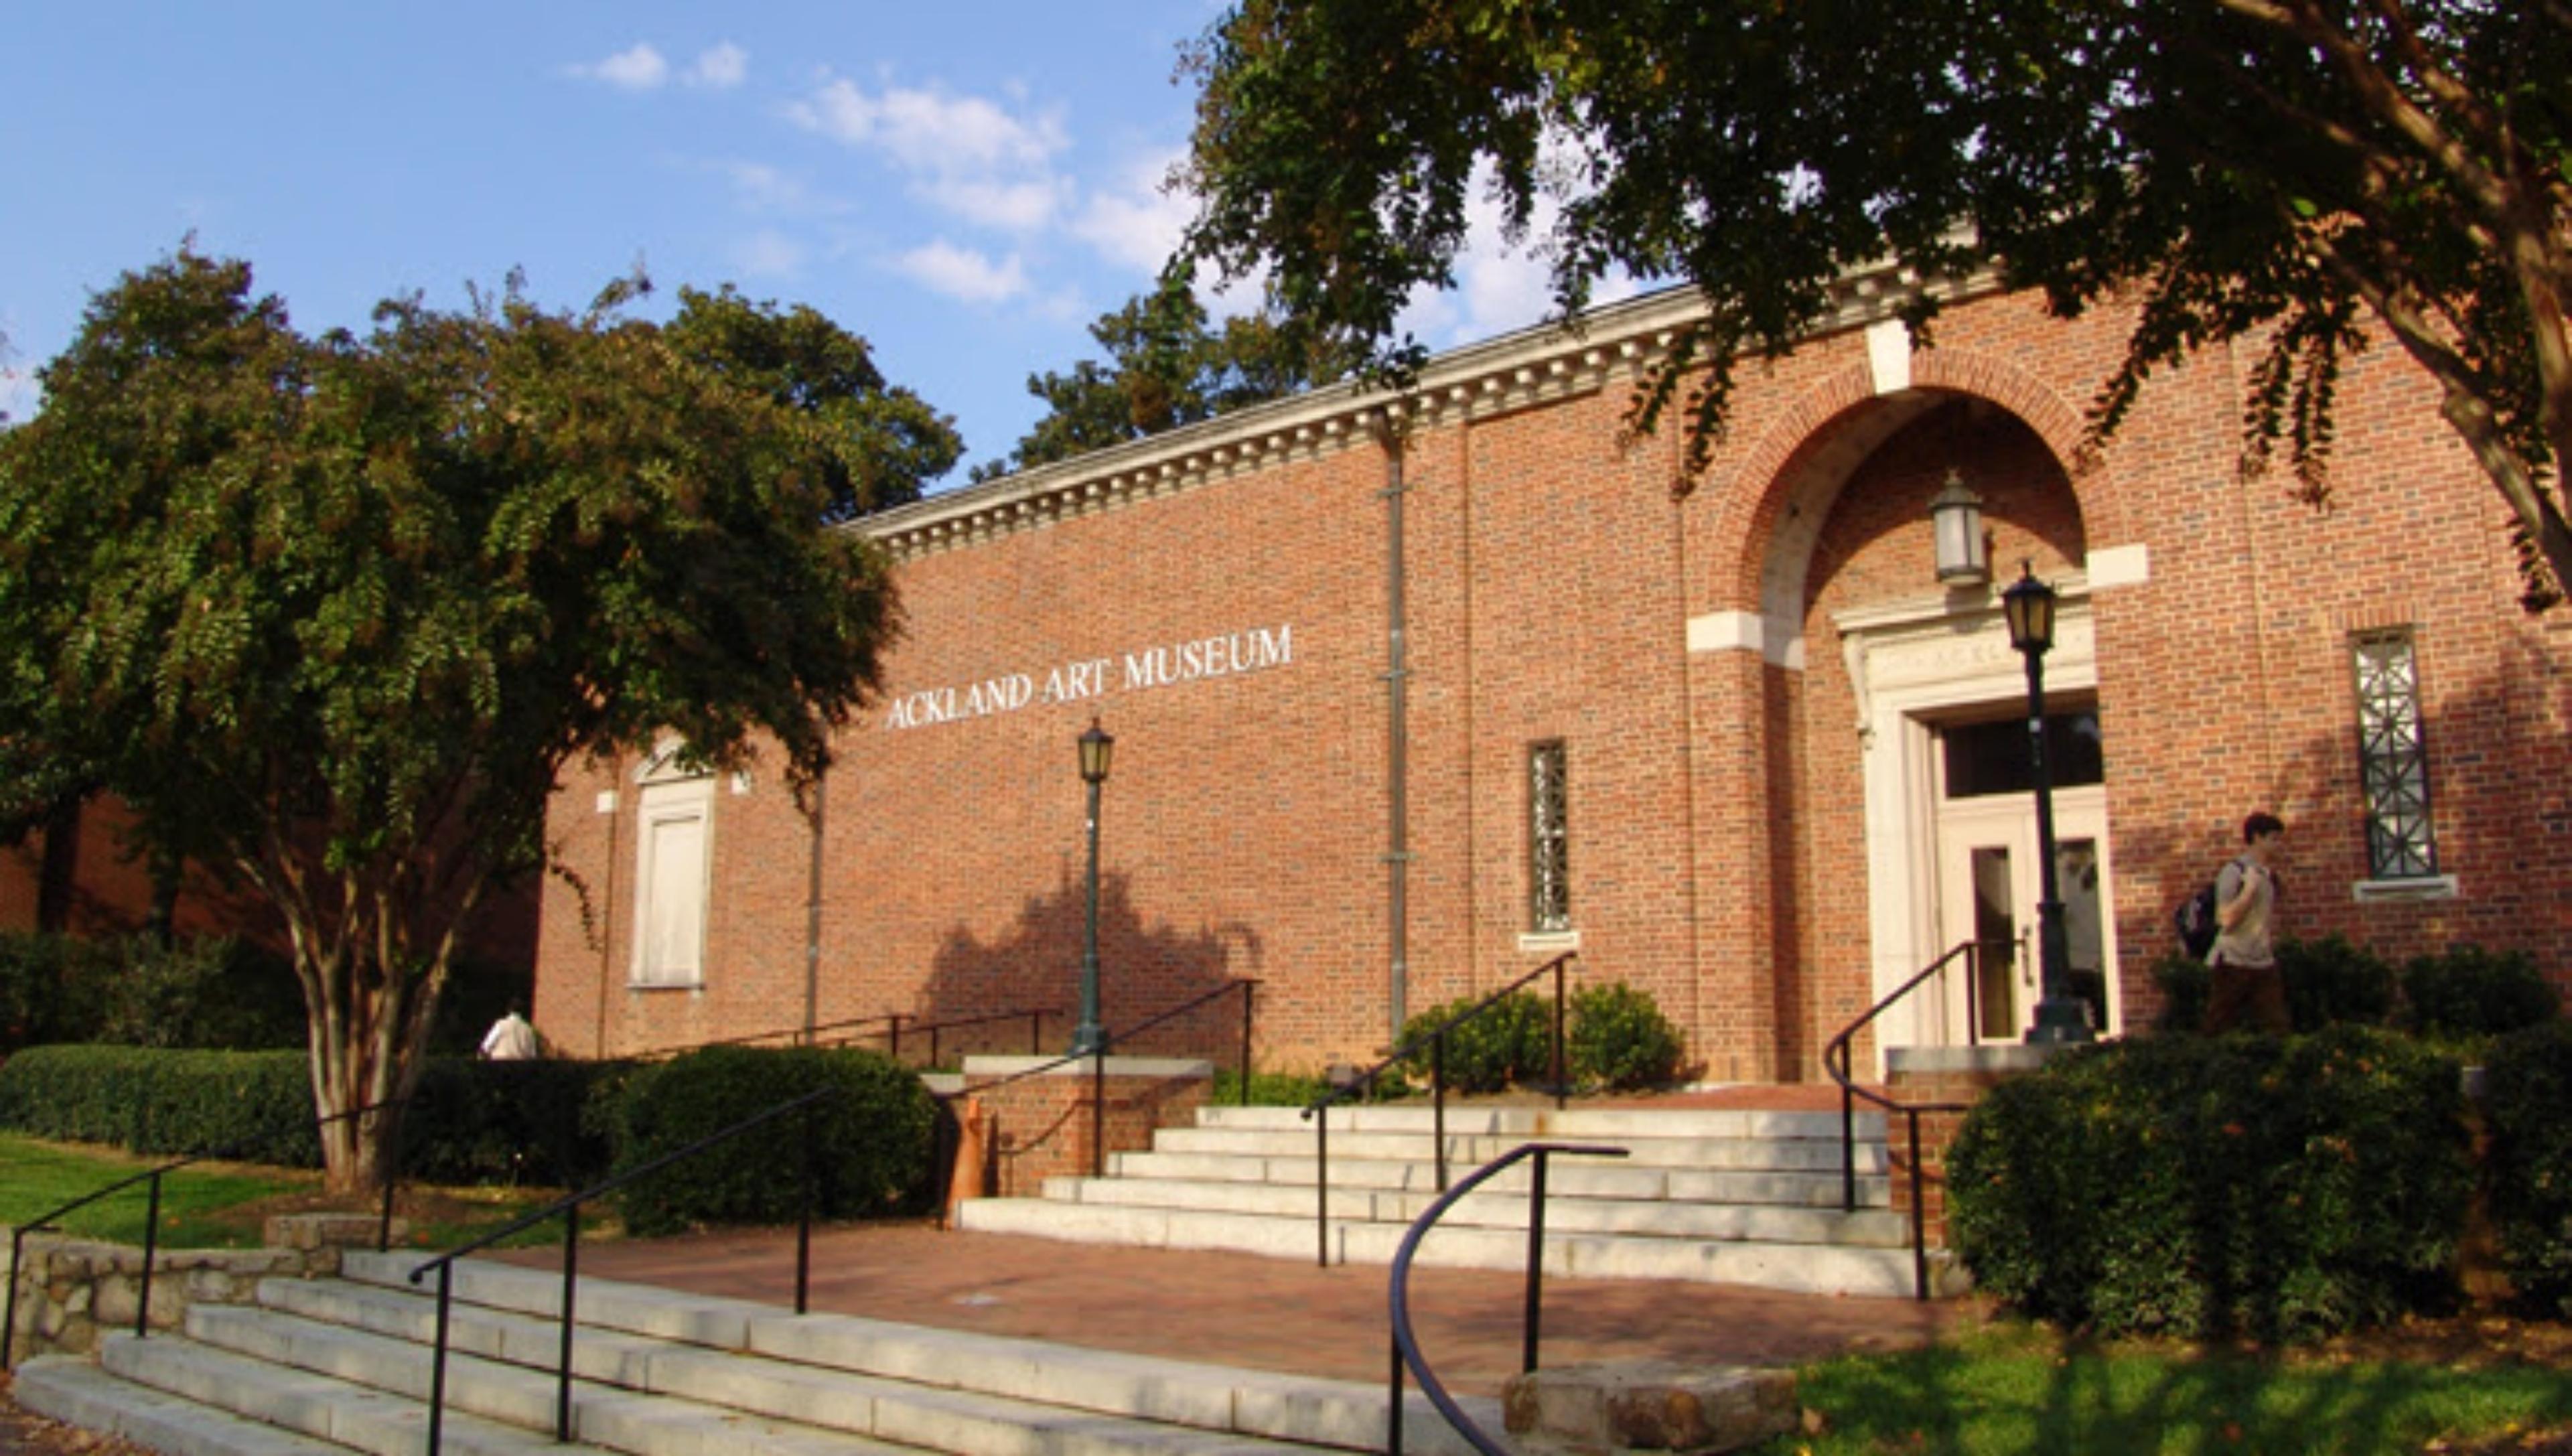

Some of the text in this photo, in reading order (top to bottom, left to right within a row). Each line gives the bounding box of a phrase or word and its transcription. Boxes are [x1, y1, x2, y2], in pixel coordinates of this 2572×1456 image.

[886, 624, 1293, 730] ACKLAND ART MUSEUM
